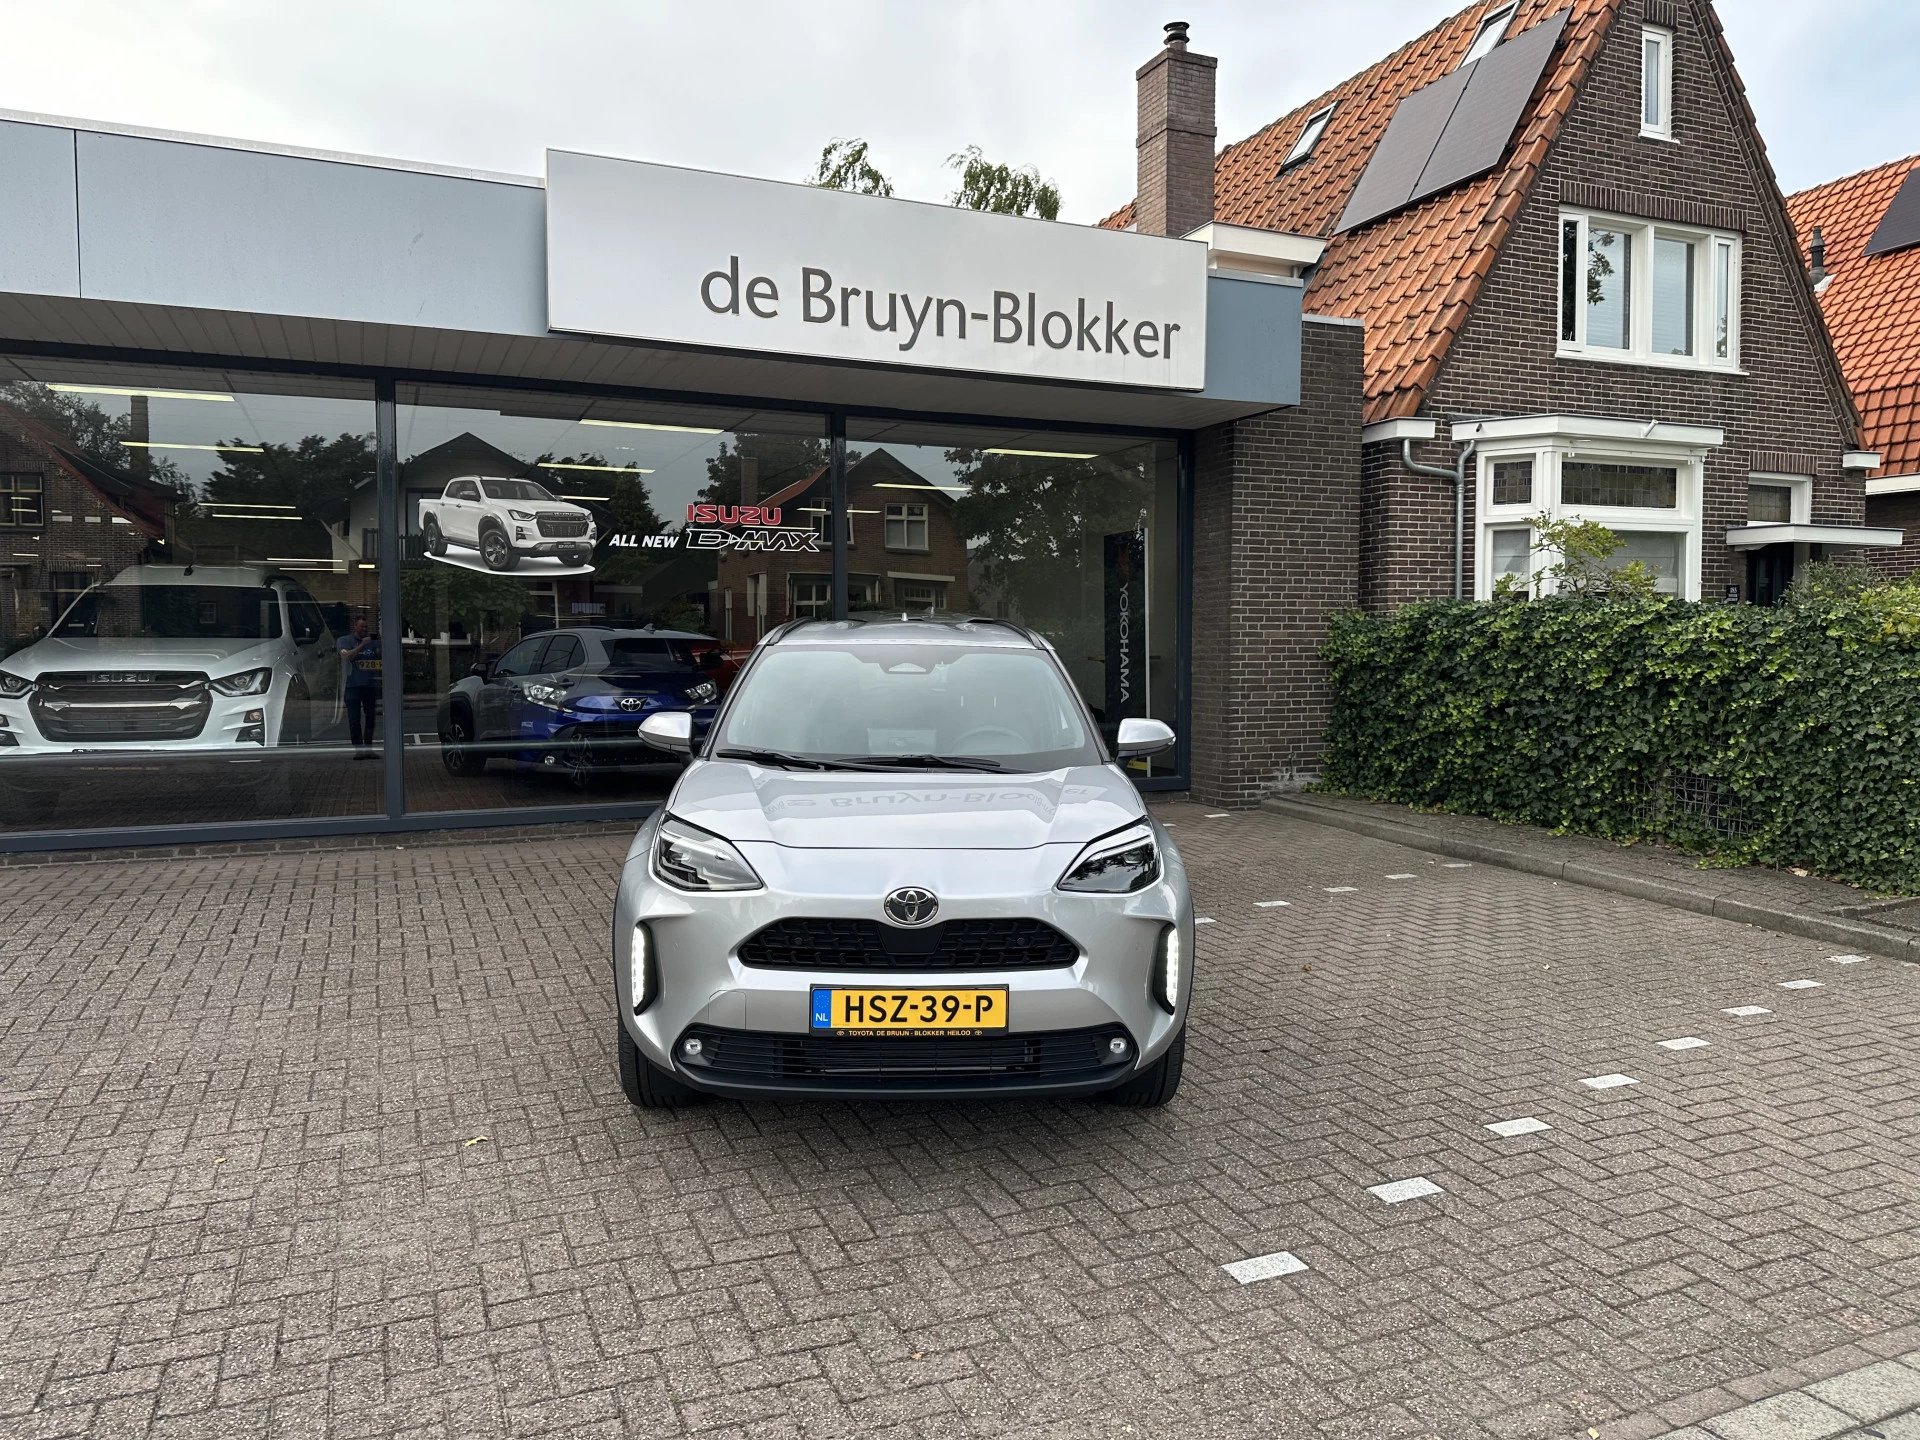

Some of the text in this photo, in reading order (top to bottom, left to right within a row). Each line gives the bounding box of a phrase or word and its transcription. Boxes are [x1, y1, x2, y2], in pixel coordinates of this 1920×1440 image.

[700, 255, 1181, 359] de Bruyn-Blokker
[686, 503, 782, 526] ISUZU
[609, 534, 639, 548] ALL
[641, 535, 680, 549] NEW
[1119, 582, 1130, 703] YOKOHAMA
[91, 672, 150, 683] ISUZU
[815, 1013, 828, 1022] NL
[845, 995, 993, 1023] HSZ-39-P
[848, 1029, 874, 1037] TOYOTA
[876, 1029, 886, 1037] DE
[914, 1029, 945, 1037] BLOKKER
[947, 1029, 971, 1037] HEILOO
